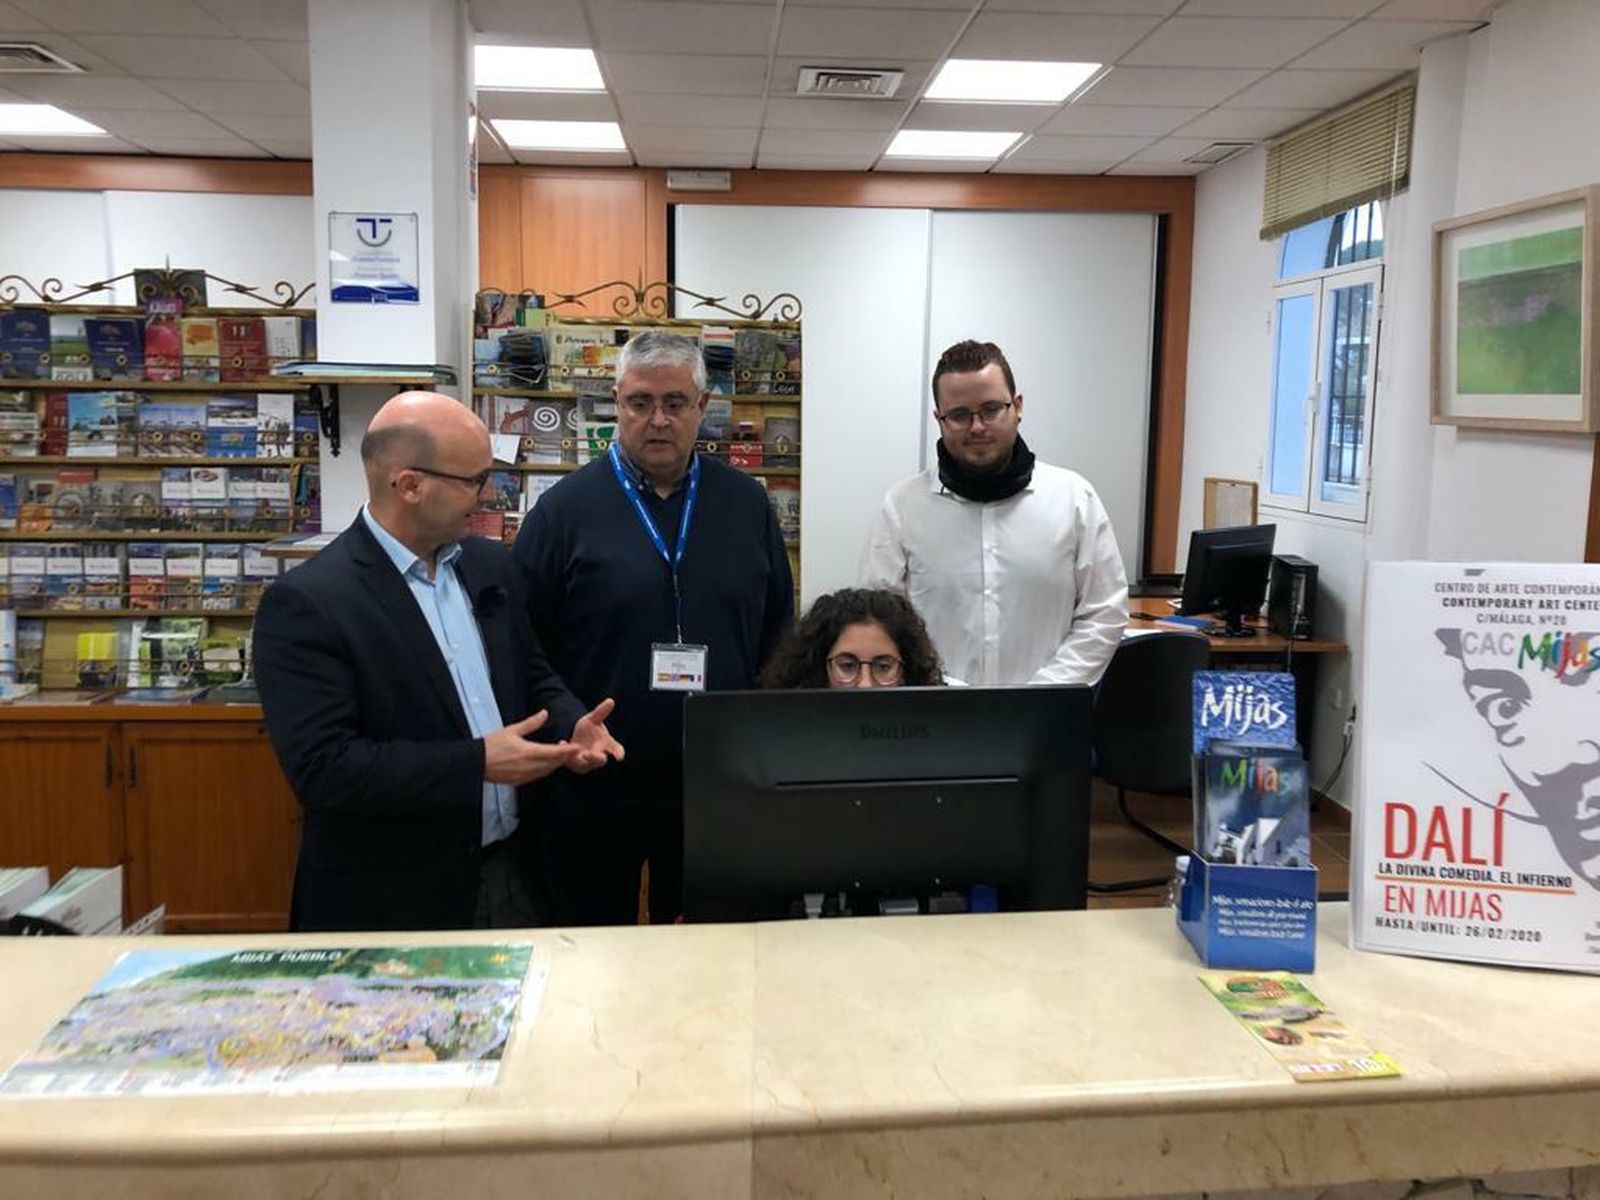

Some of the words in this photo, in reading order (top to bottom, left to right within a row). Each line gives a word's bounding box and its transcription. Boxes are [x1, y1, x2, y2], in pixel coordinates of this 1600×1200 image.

[1435, 582, 1474, 594] CENTRO
[1477, 583, 1490, 594] DE
[1495, 584, 1520, 595] ARTE
[1442, 597, 1533, 609] CONTEMPORARY
[1538, 599, 1561, 610] ART
[1564, 600, 1600, 611] CENTE
[1462, 631, 1515, 656] CAC
[1518, 631, 1600, 679] Mijas
[1201, 683, 1288, 735] Mijas
[1219, 756, 1295, 798] Mijas
[1384, 792, 1510, 867] DALÍ
[1378, 862, 1393, 875] LA
[1396, 863, 1436, 878] DIVINA
[1439, 866, 1496, 883] COMEDIA.
[1500, 871, 1513, 884] EL
[1517, 872, 1573, 888] INFIERNO
[1384, 885, 1415, 915] EN
[1425, 888, 1503, 923] MIJAS
[1465, 925, 1543, 943] 26/02/2020
[279, 950, 342, 962] PUEBLO
